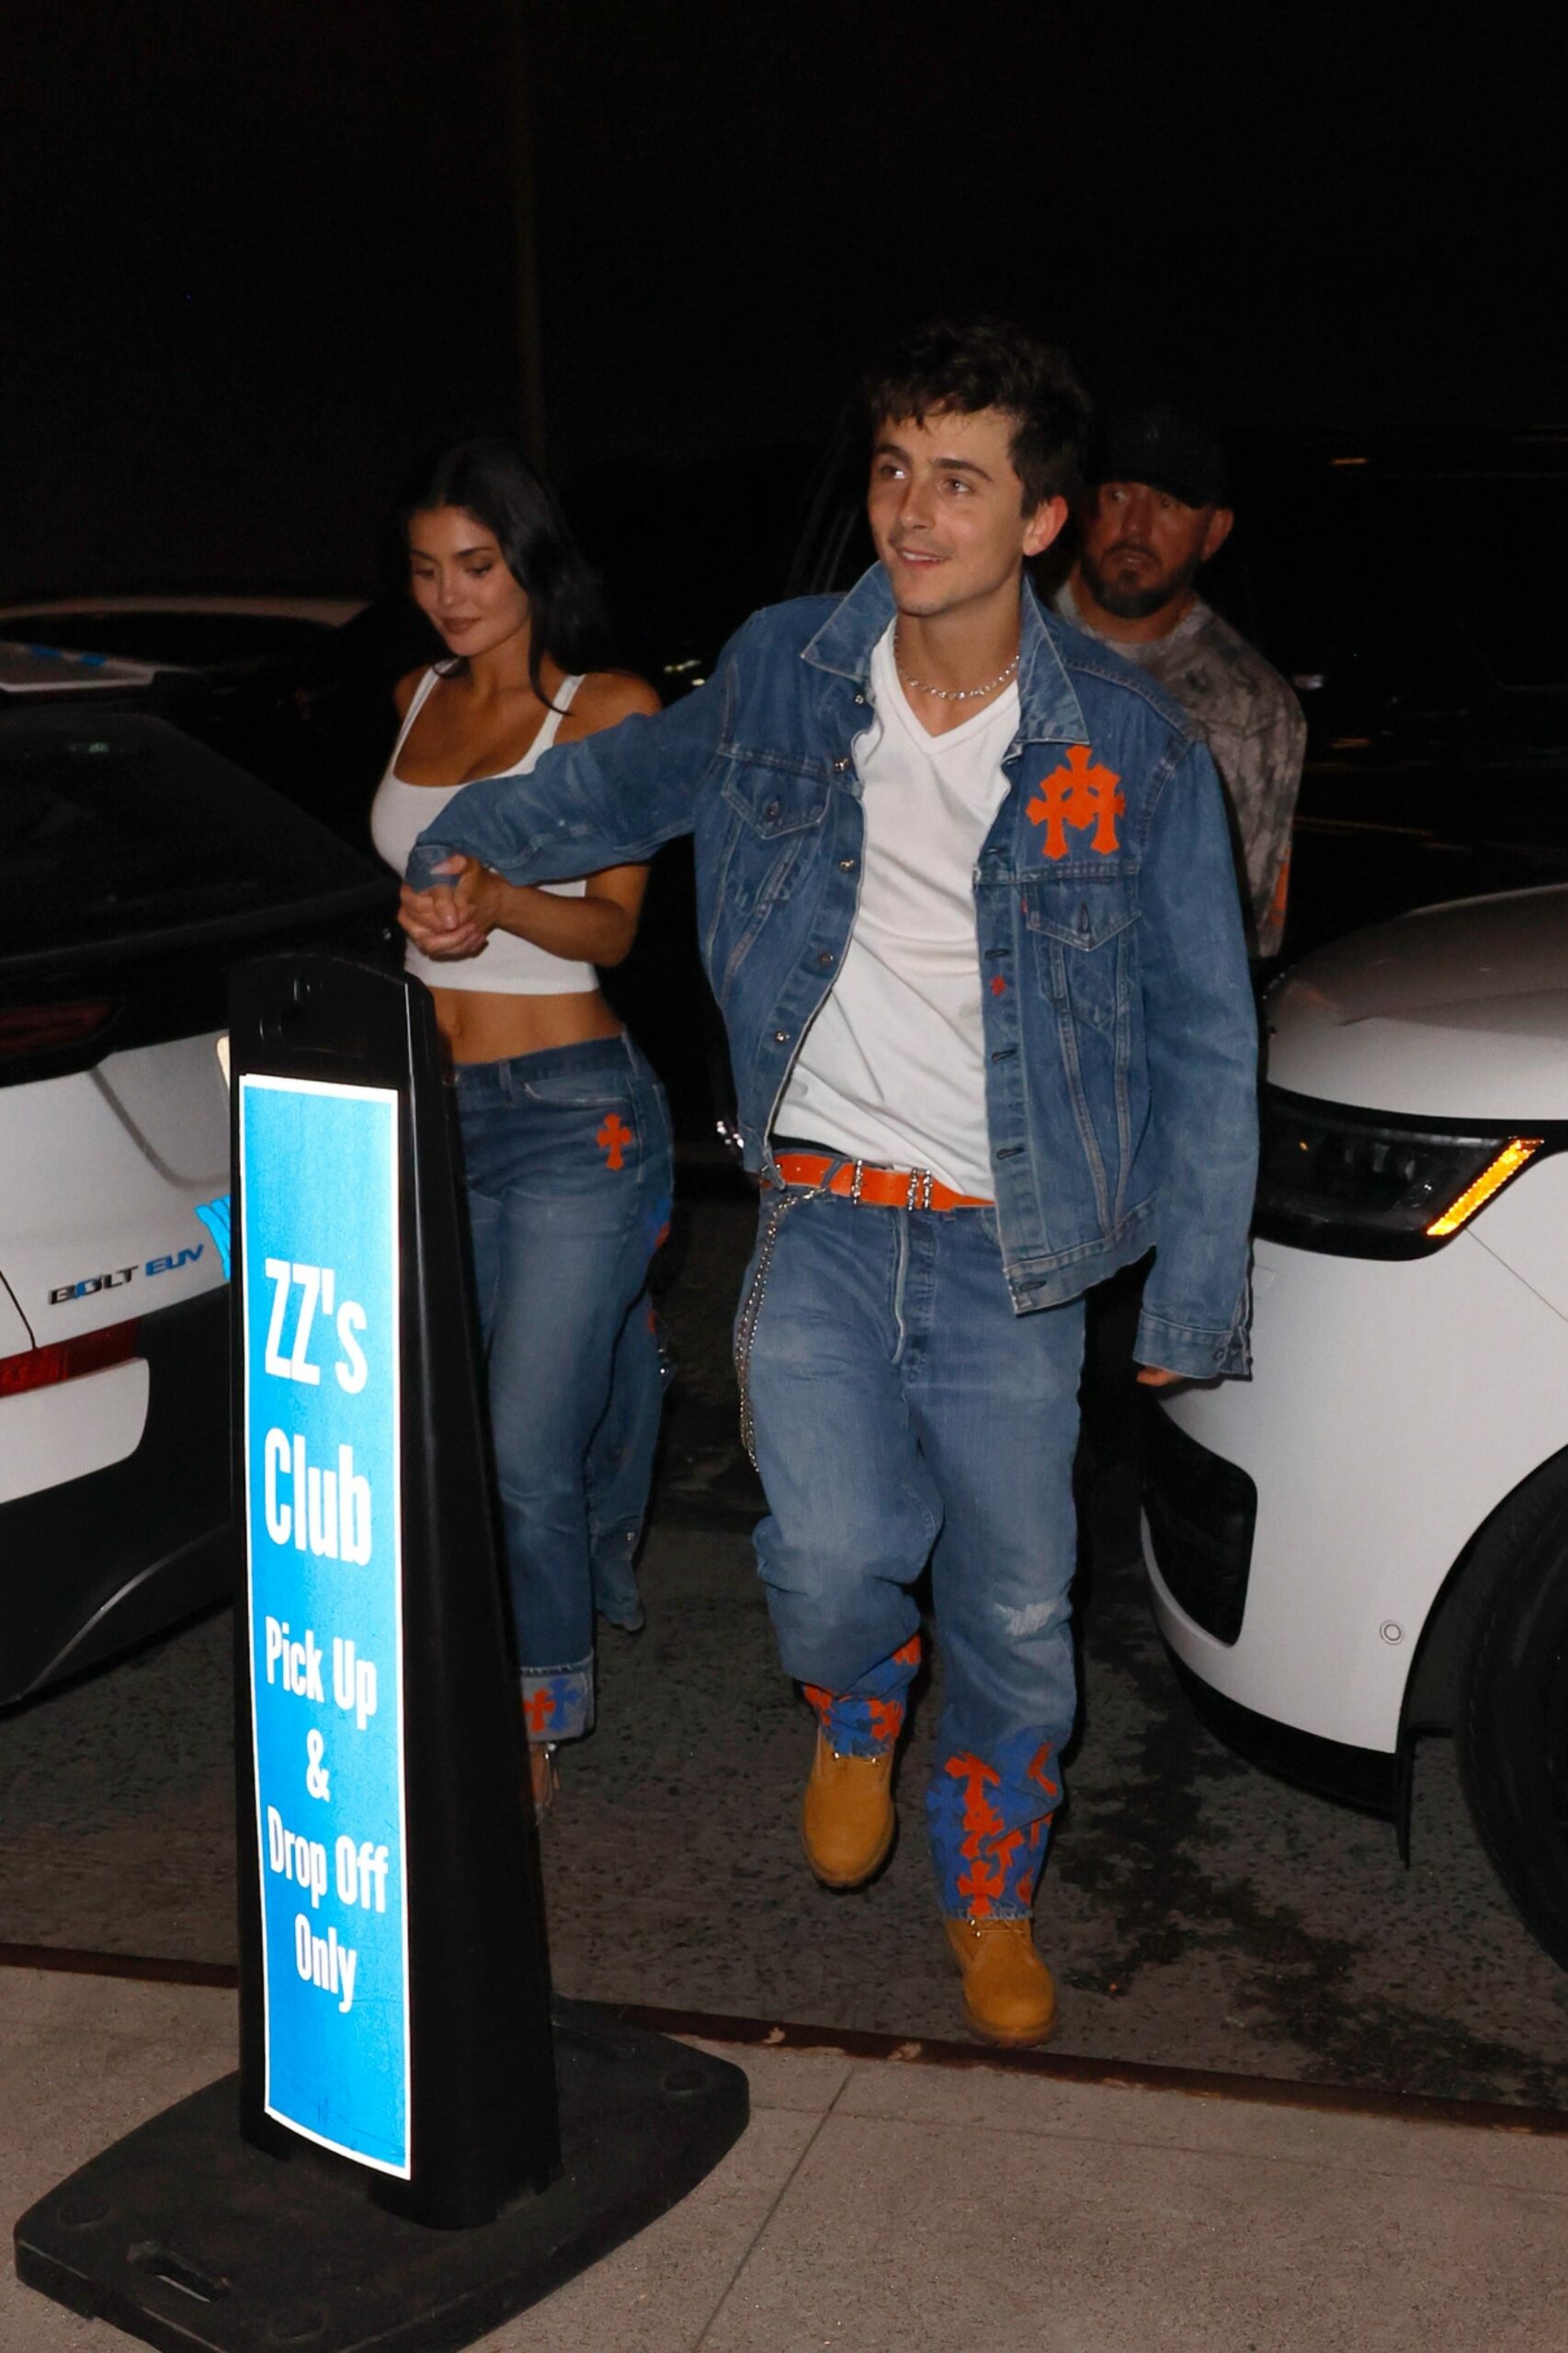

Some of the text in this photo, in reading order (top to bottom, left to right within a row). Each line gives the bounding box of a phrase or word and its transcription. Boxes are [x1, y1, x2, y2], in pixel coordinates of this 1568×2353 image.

[49, 1244, 203, 1305] BOLT EUV
[265, 1257, 369, 1394] ZZ's
[265, 1427, 372, 1566] Club
[266, 1616, 377, 1730] Pick Up
[306, 1729, 330, 1802] &
[267, 1805, 389, 1914] Drop Off
[295, 1914, 357, 2013] Only
